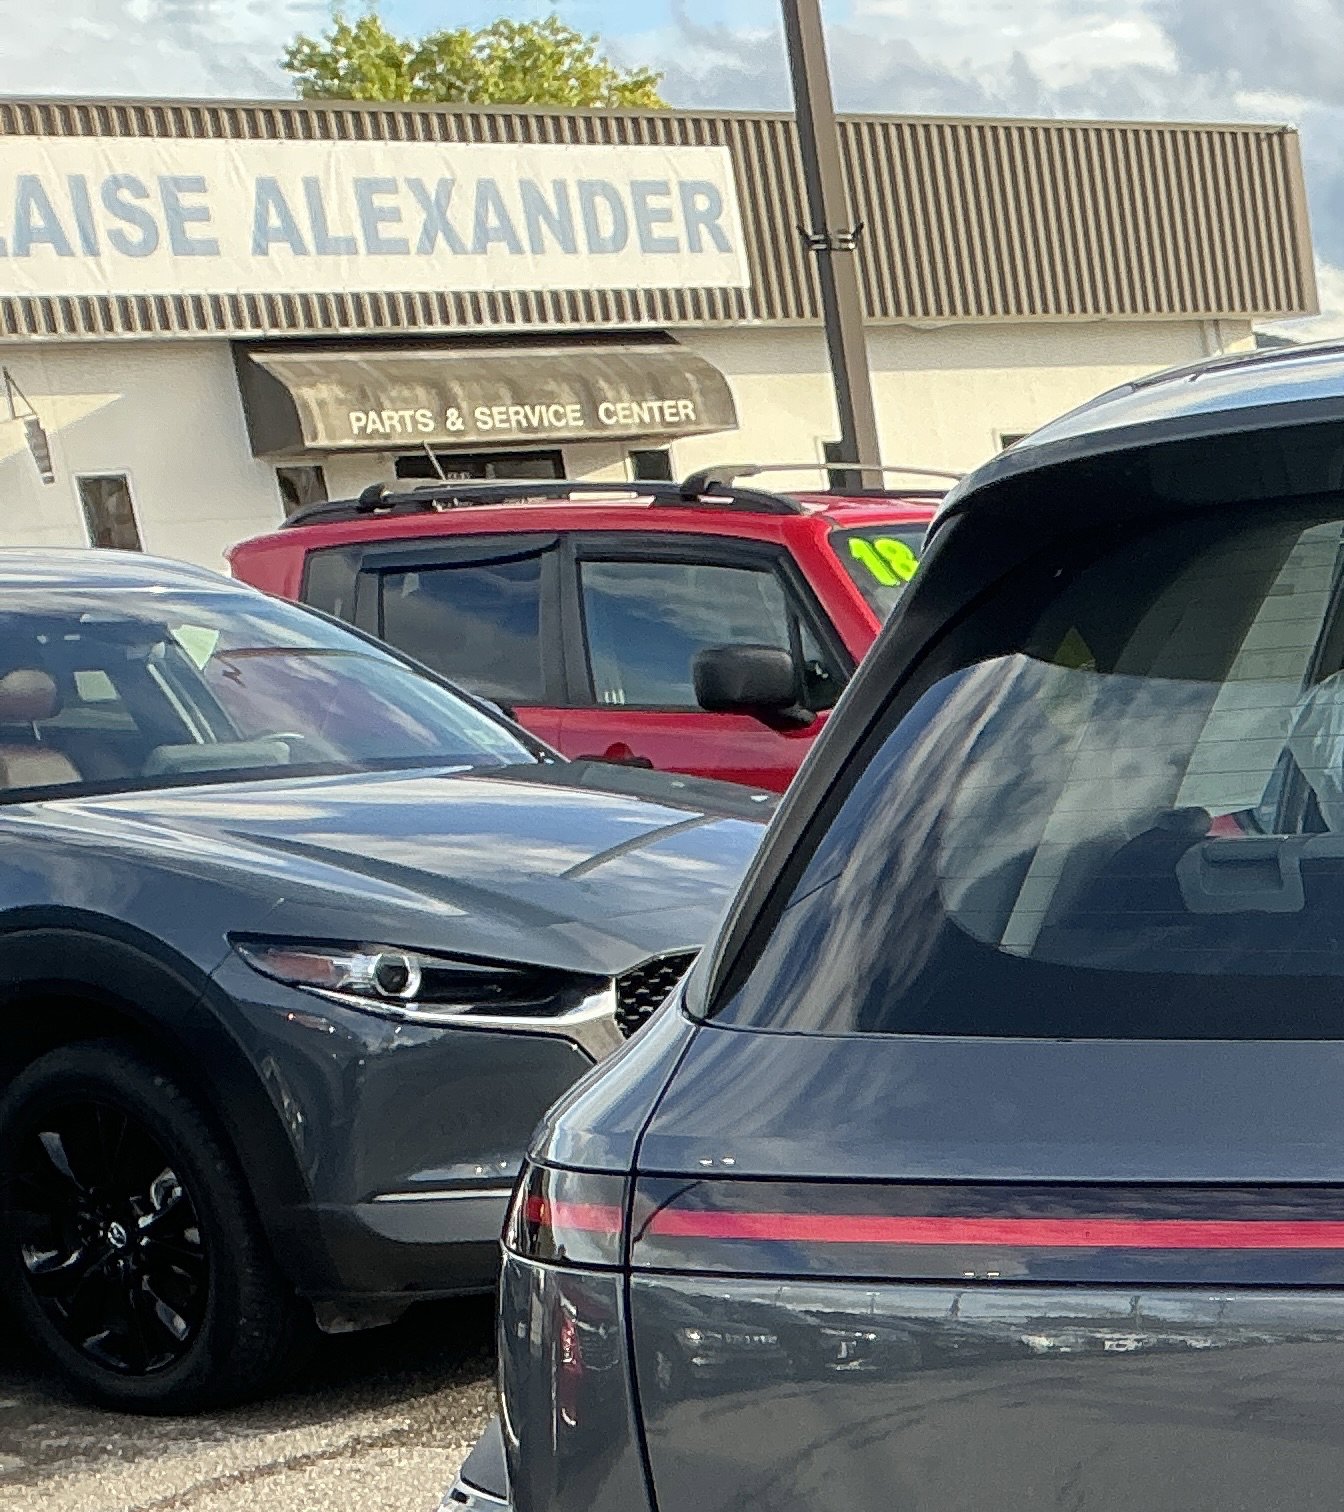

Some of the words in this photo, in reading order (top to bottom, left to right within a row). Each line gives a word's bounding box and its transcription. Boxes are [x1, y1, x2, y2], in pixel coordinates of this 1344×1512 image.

[251, 175, 733, 257] ALEXANDER
[350, 409, 435, 435] PARTS
[446, 406, 465, 432] &
[475, 403, 584, 431] SERVICE
[599, 399, 697, 425] CENTER
[847, 537, 920, 588] 18
